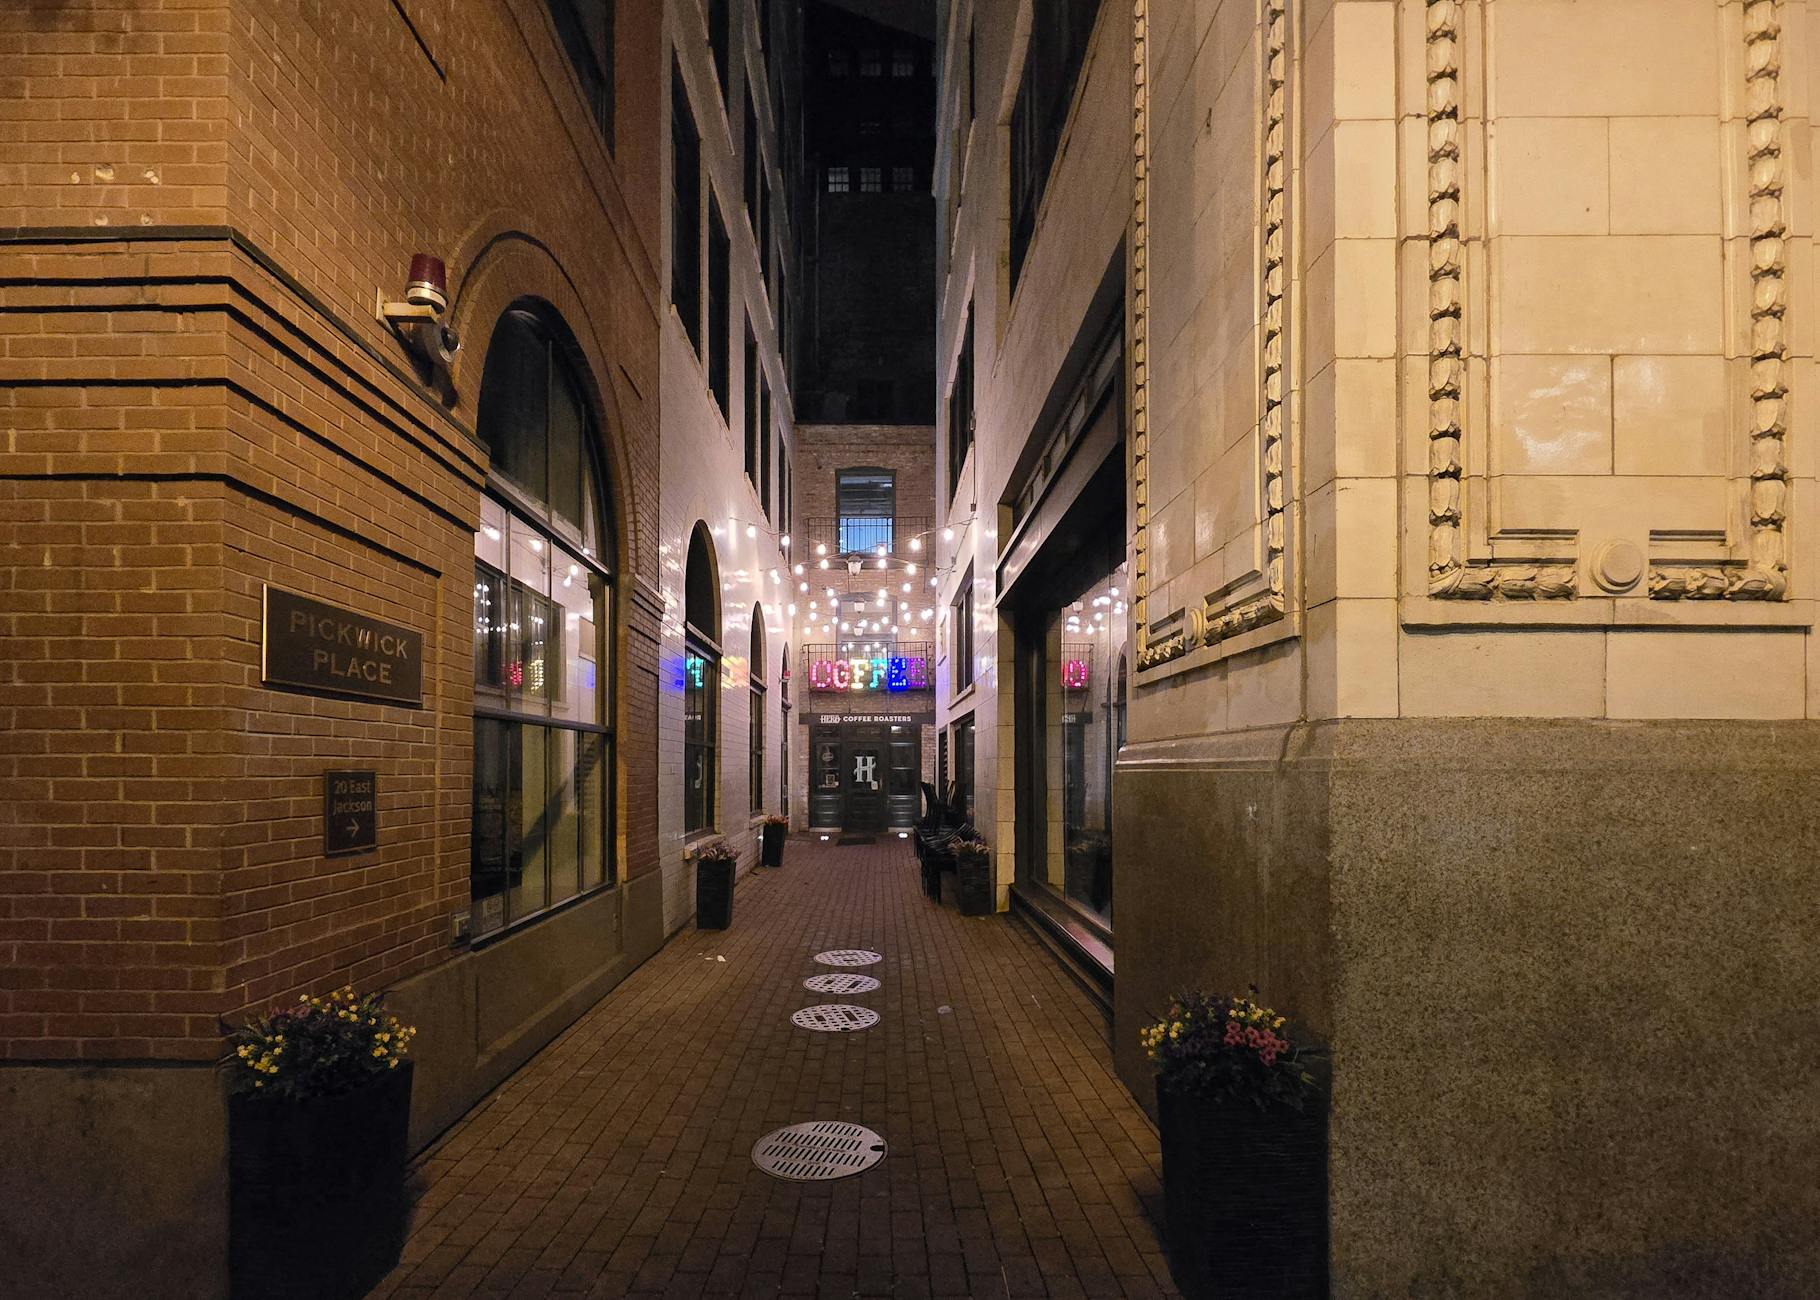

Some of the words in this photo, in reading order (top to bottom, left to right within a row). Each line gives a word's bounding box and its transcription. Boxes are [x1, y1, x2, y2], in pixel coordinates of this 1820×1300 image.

[289, 610, 408, 659] PICKWICK
[313, 649, 392, 685] PLACE
[350, 780, 372, 794] East
[332, 798, 373, 816] Jackson
